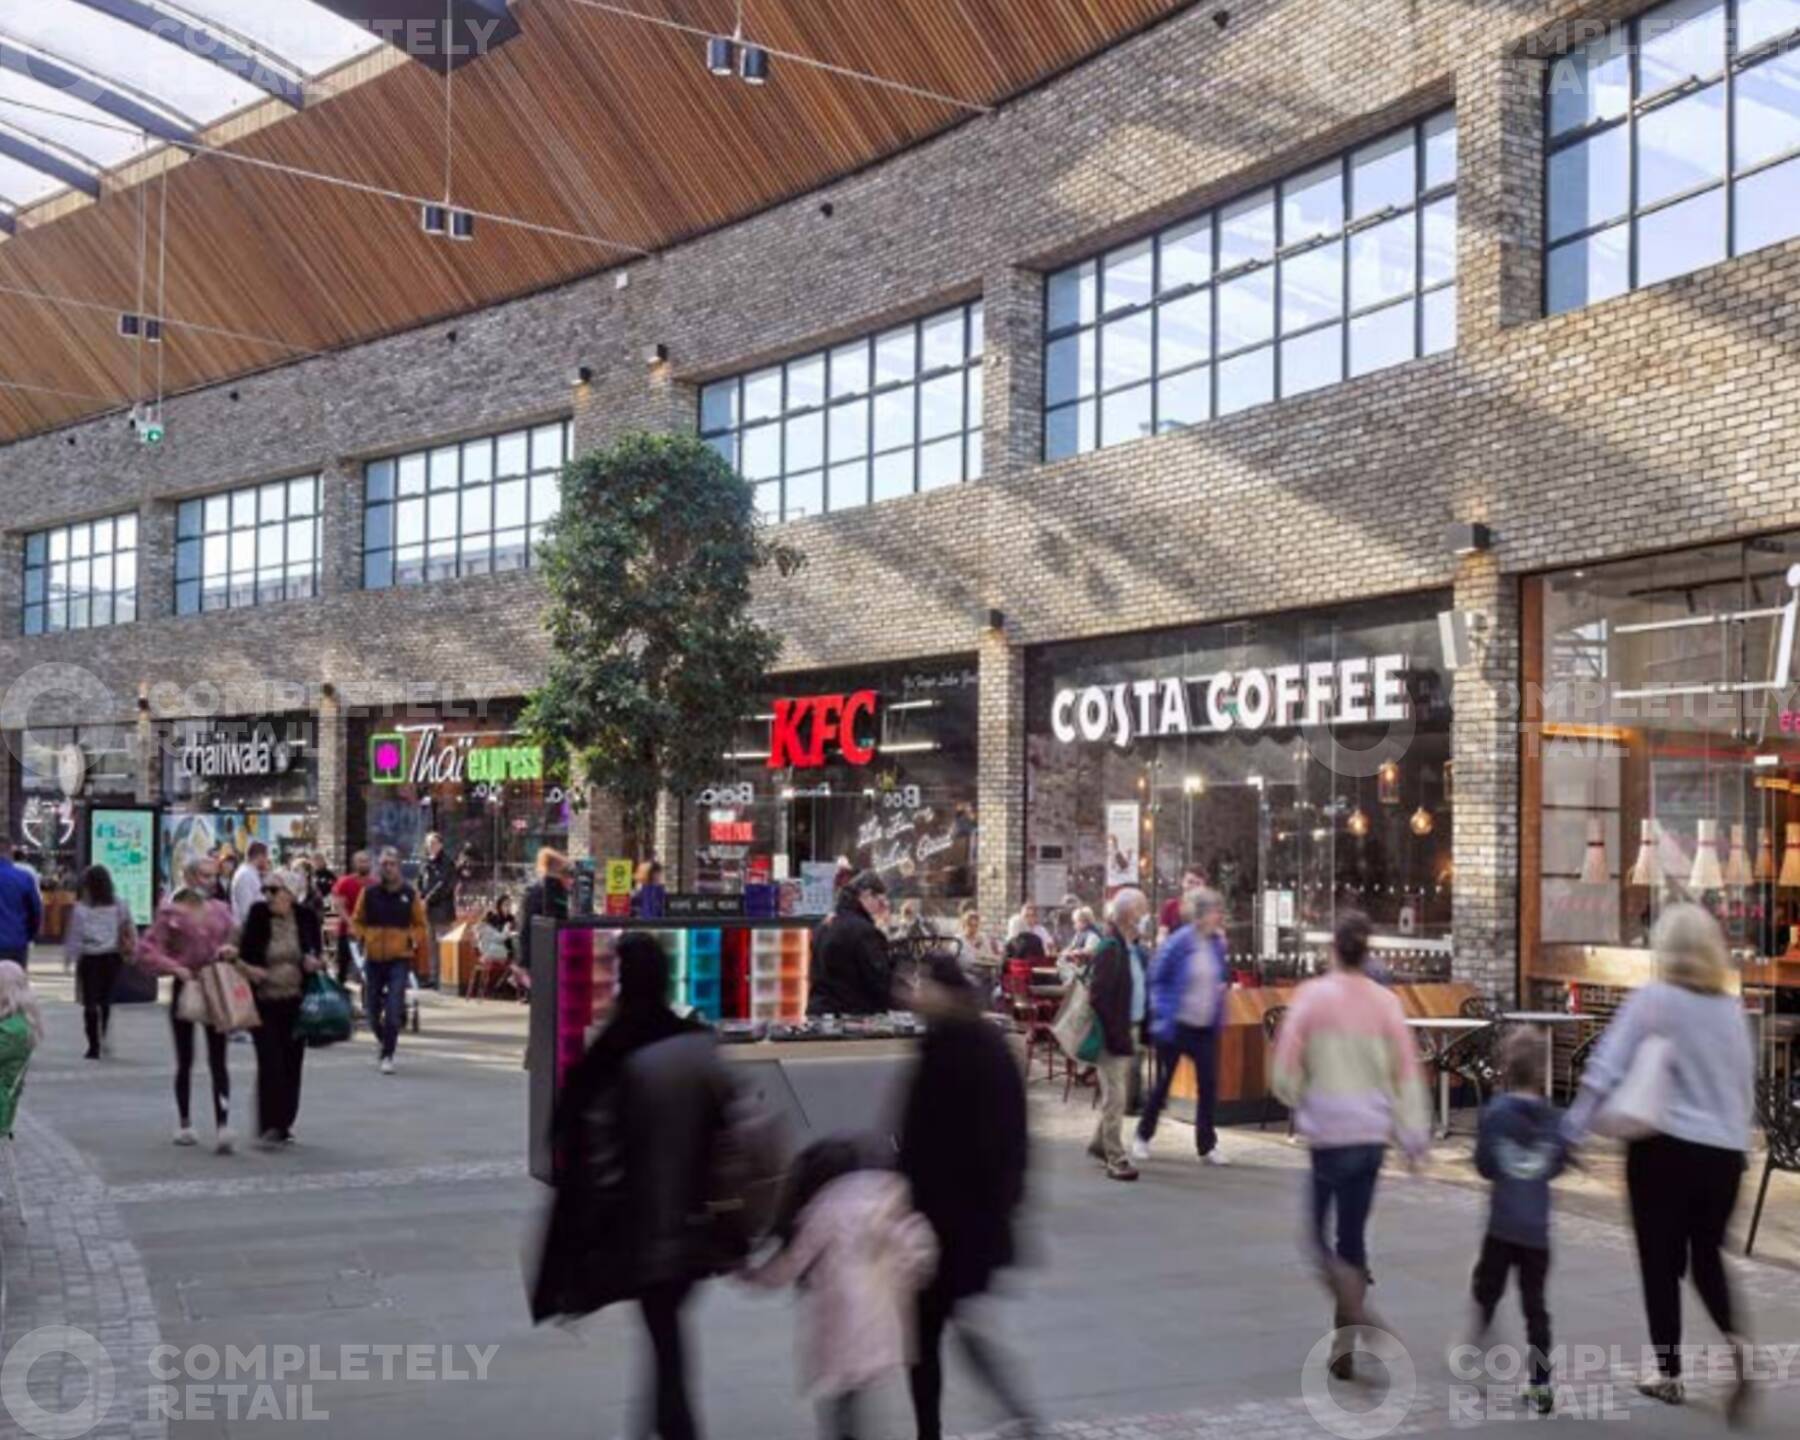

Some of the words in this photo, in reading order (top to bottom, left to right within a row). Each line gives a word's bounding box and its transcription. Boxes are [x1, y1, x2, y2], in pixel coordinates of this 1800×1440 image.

[766, 689, 877, 769] KFC
[1051, 676, 1190, 747] COSTA
[1206, 653, 1409, 731] COFFEE
[394, 723, 474, 783] Thaï
